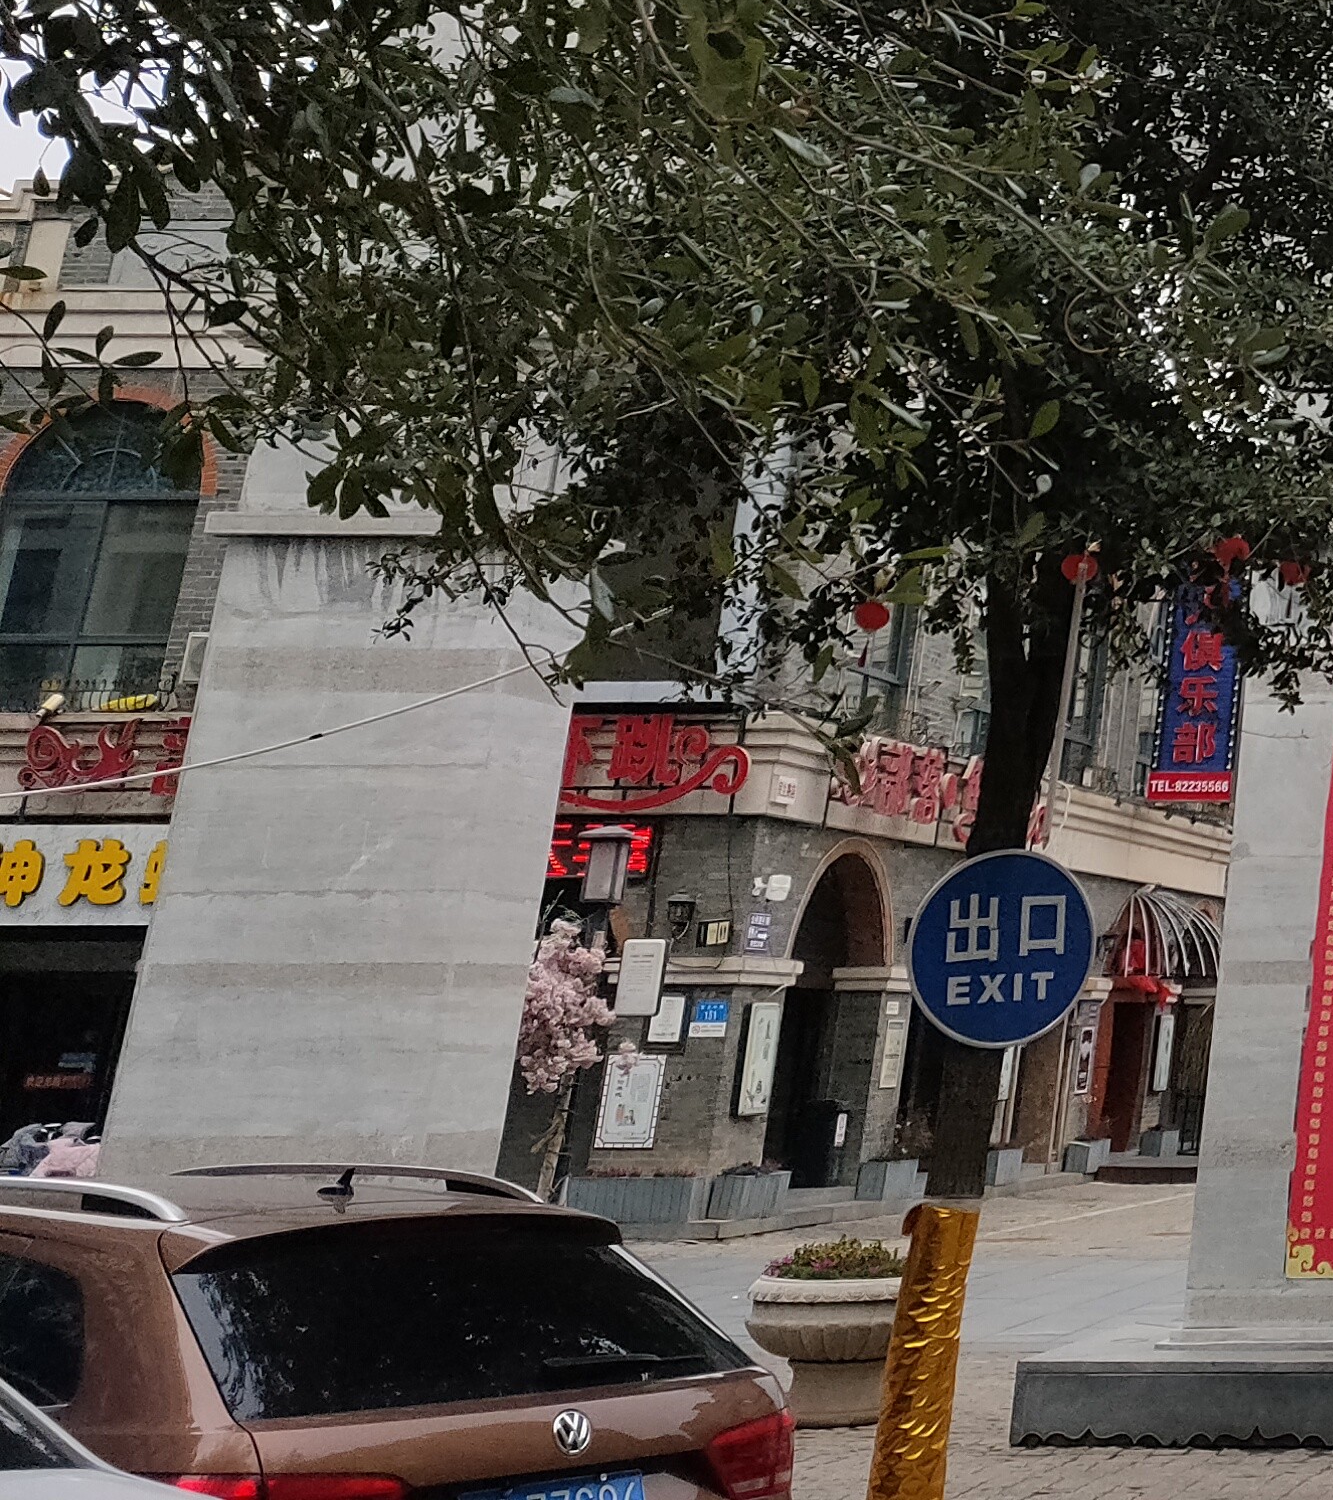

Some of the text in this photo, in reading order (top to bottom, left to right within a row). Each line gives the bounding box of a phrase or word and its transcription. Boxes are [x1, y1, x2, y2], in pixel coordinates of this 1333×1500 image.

[1172, 585, 1225, 764] 俱乐部
[945, 893, 1067, 963] 出口
[946, 971, 1055, 1007] EXIT
